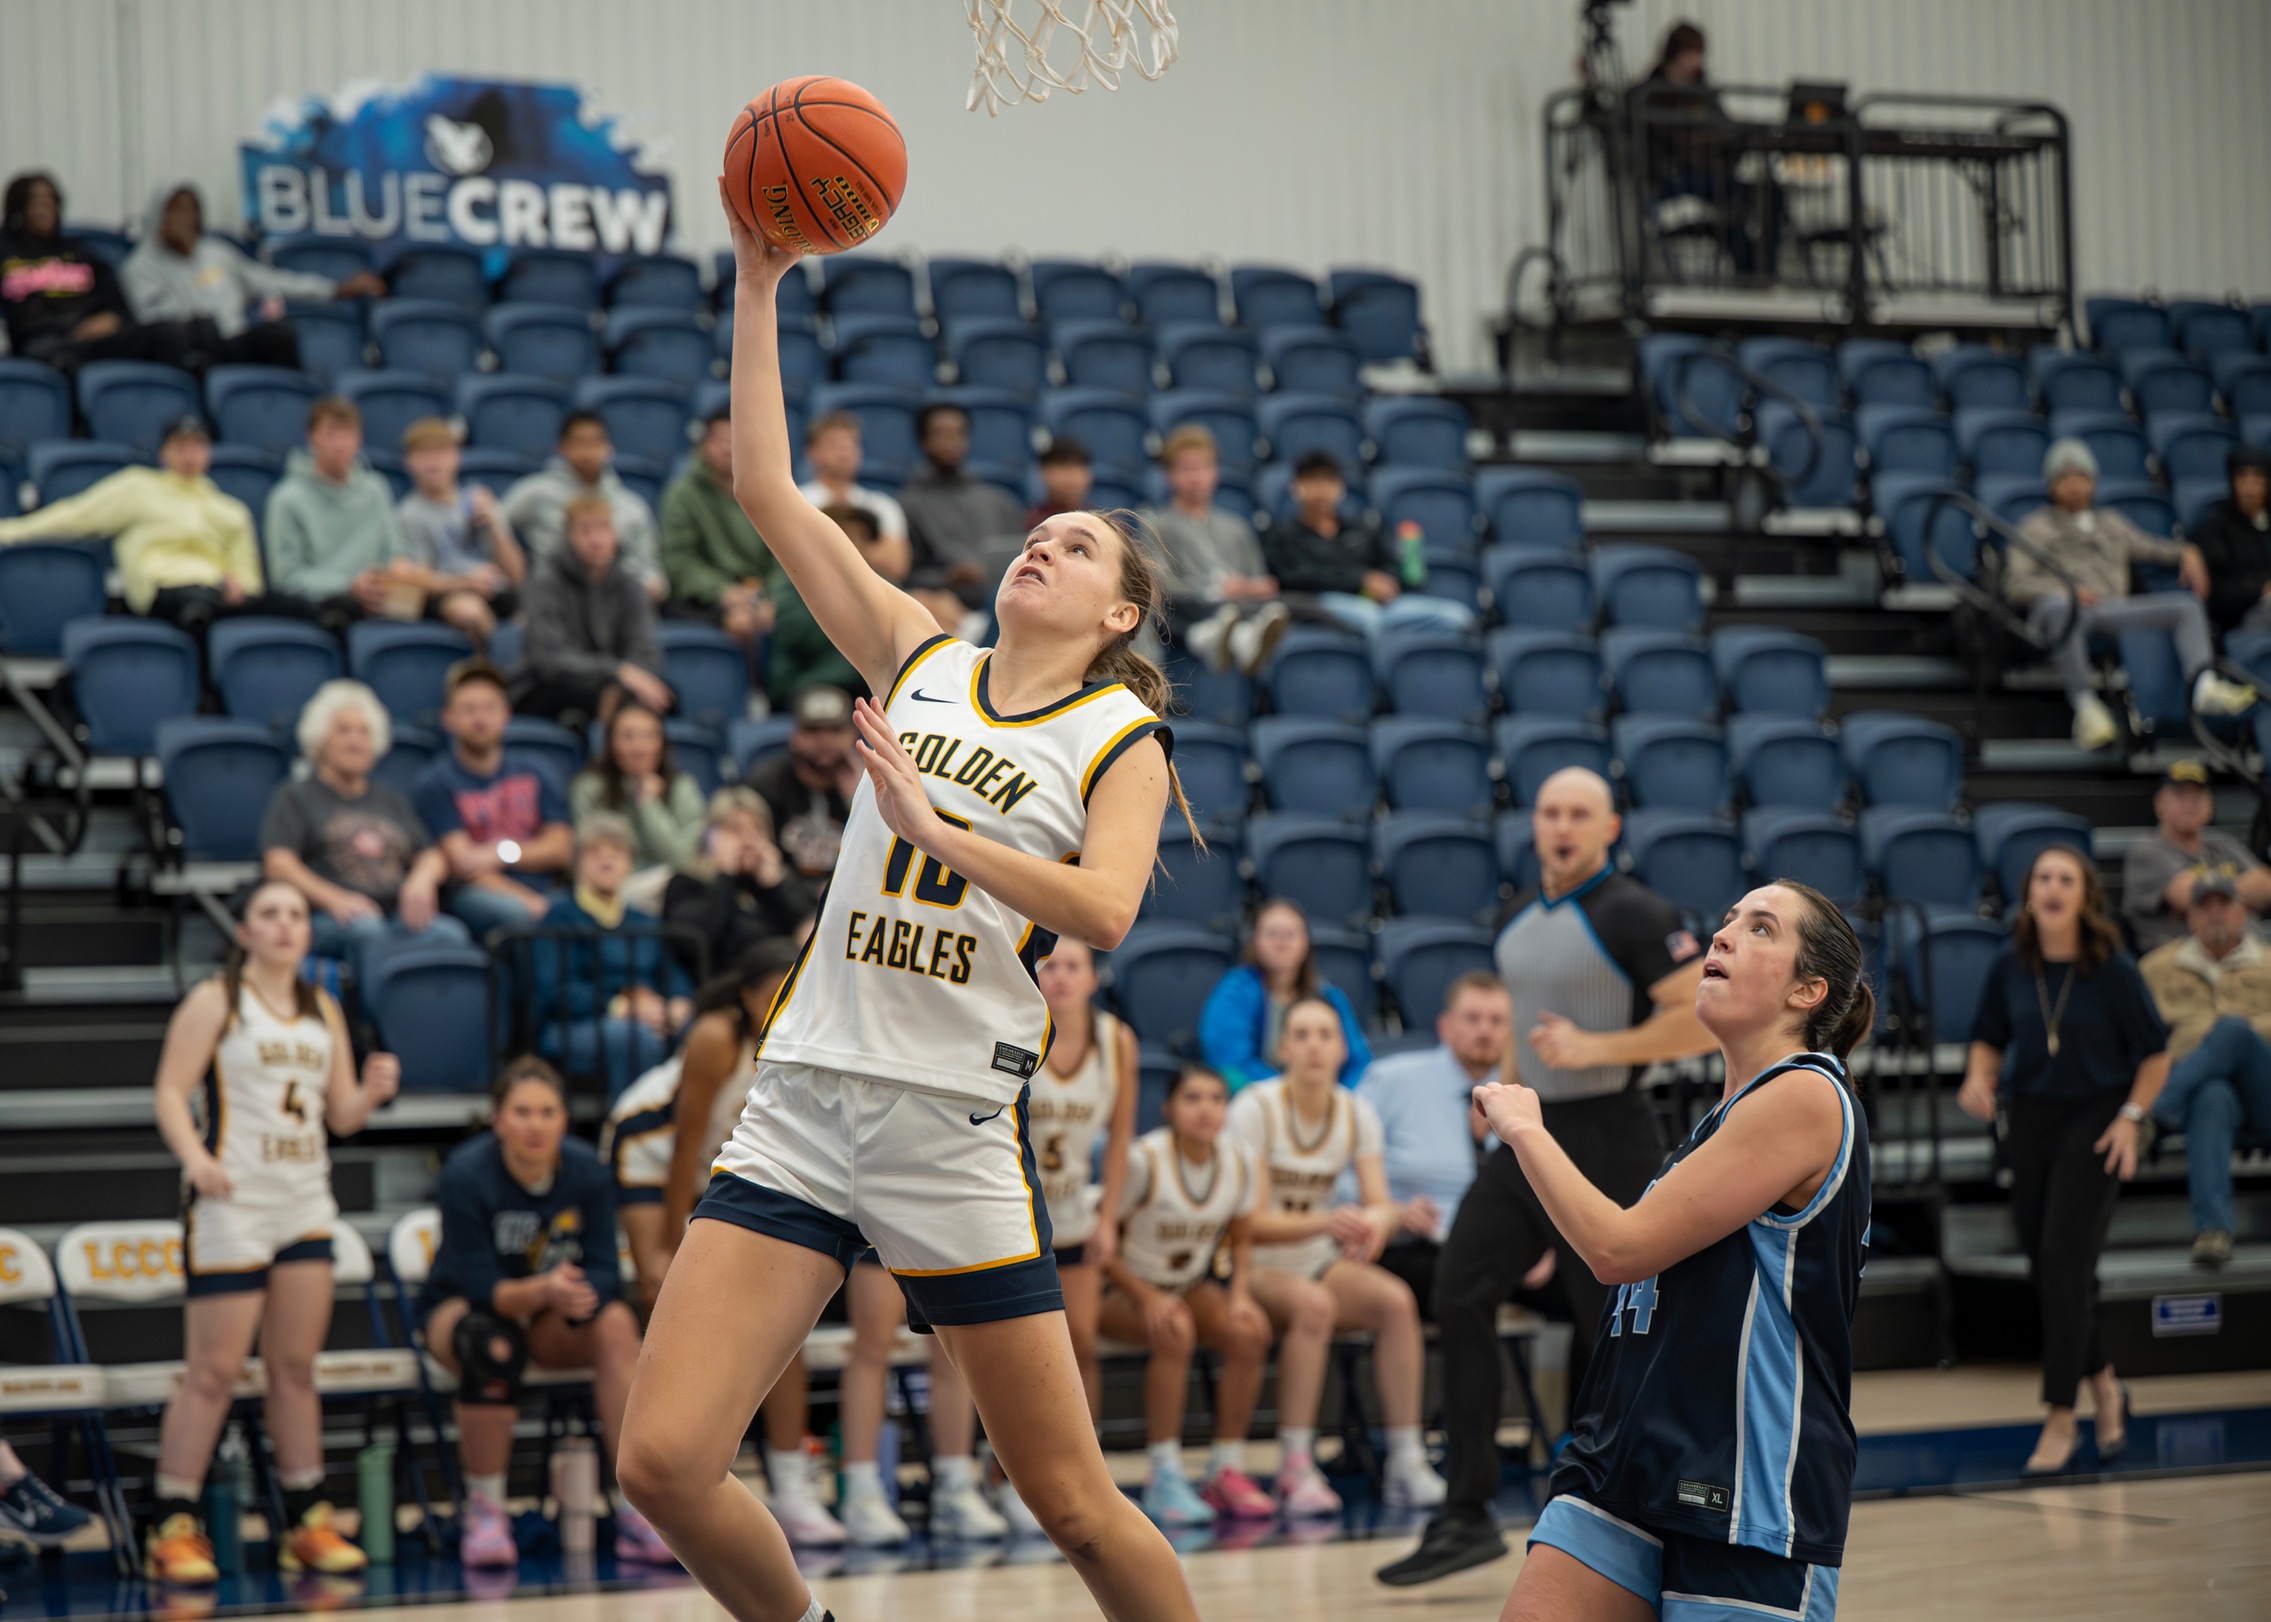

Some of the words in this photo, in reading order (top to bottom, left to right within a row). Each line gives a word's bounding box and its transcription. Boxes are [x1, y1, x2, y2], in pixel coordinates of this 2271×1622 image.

[762, 185, 828, 254] ALDING
[810, 175, 870, 246] LEGACY
[834, 175, 872, 222] 1000
[899, 732, 1039, 816] GOLDEN
[846, 910, 978, 985] EAGLES
[1024, 1060, 1034, 1072] M
[282, 1079, 307, 1125] 4
[1711, 1492, 1723, 1505] XL
